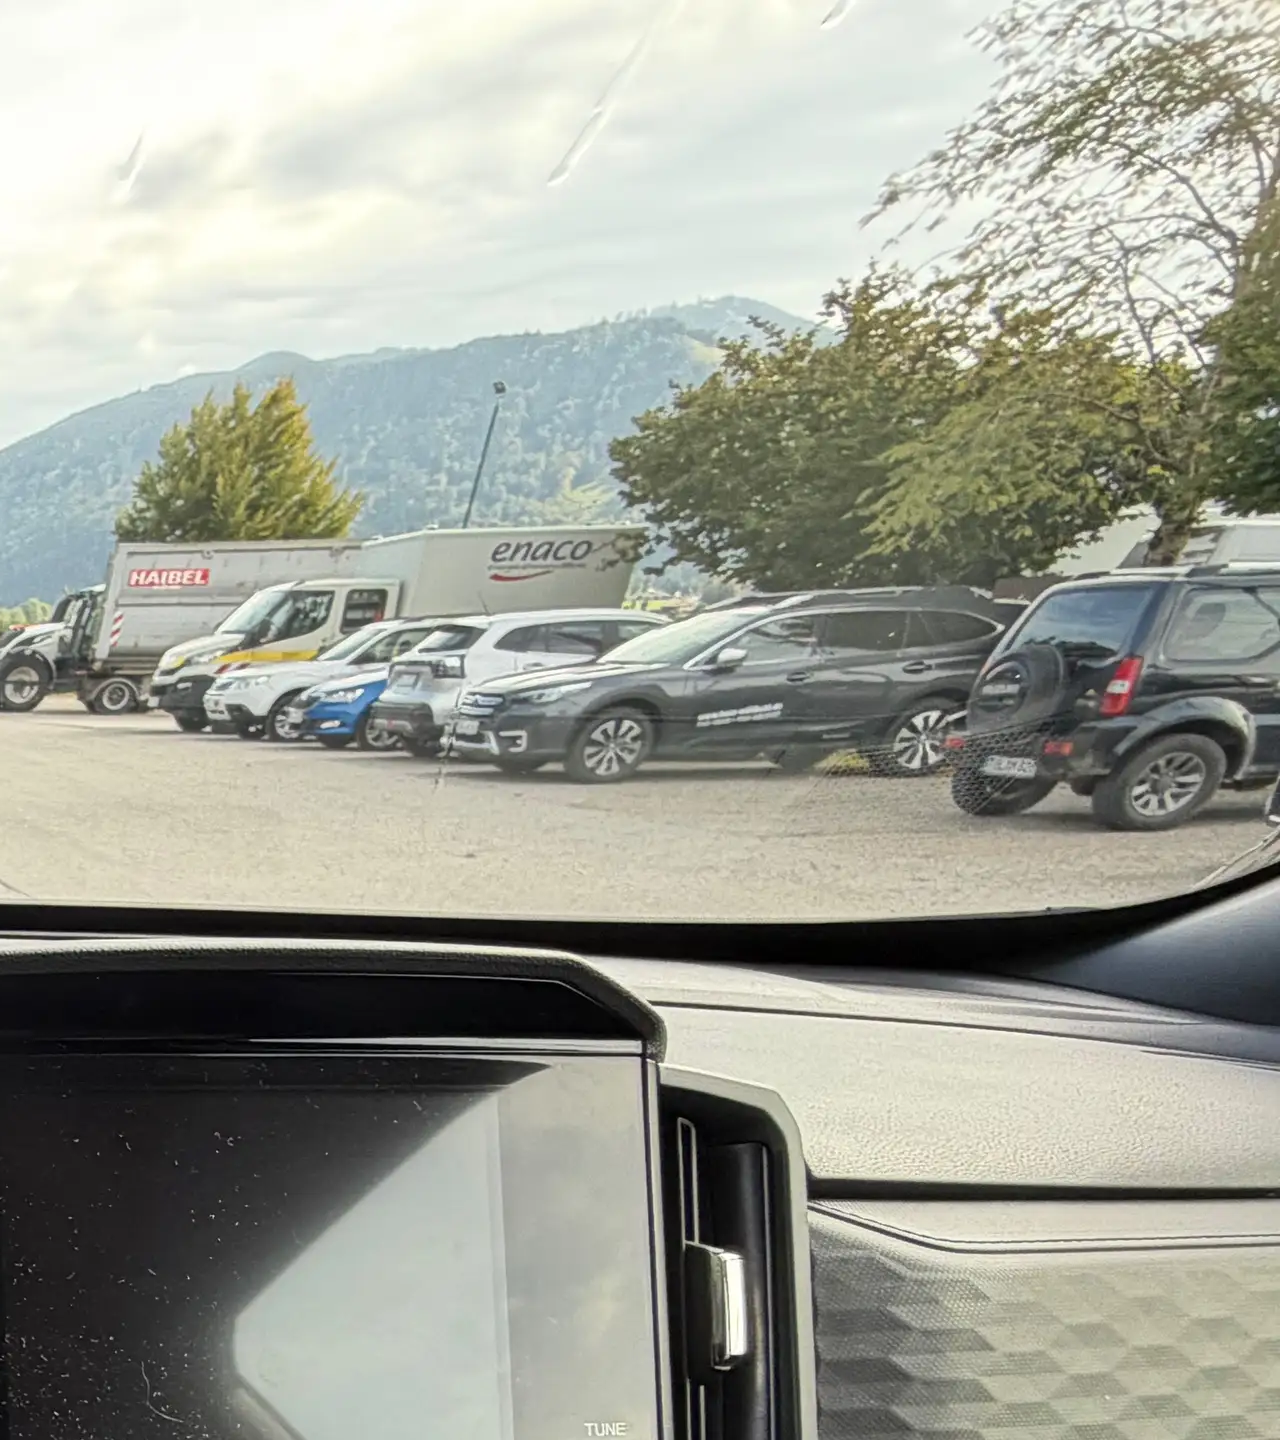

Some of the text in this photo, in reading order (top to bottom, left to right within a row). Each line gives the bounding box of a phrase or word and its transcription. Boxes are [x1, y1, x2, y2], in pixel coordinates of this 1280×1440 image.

[491, 540, 593, 562] enaco
[129, 570, 207, 586] HAIBEL
[584, 1423, 627, 1437] TUNE
